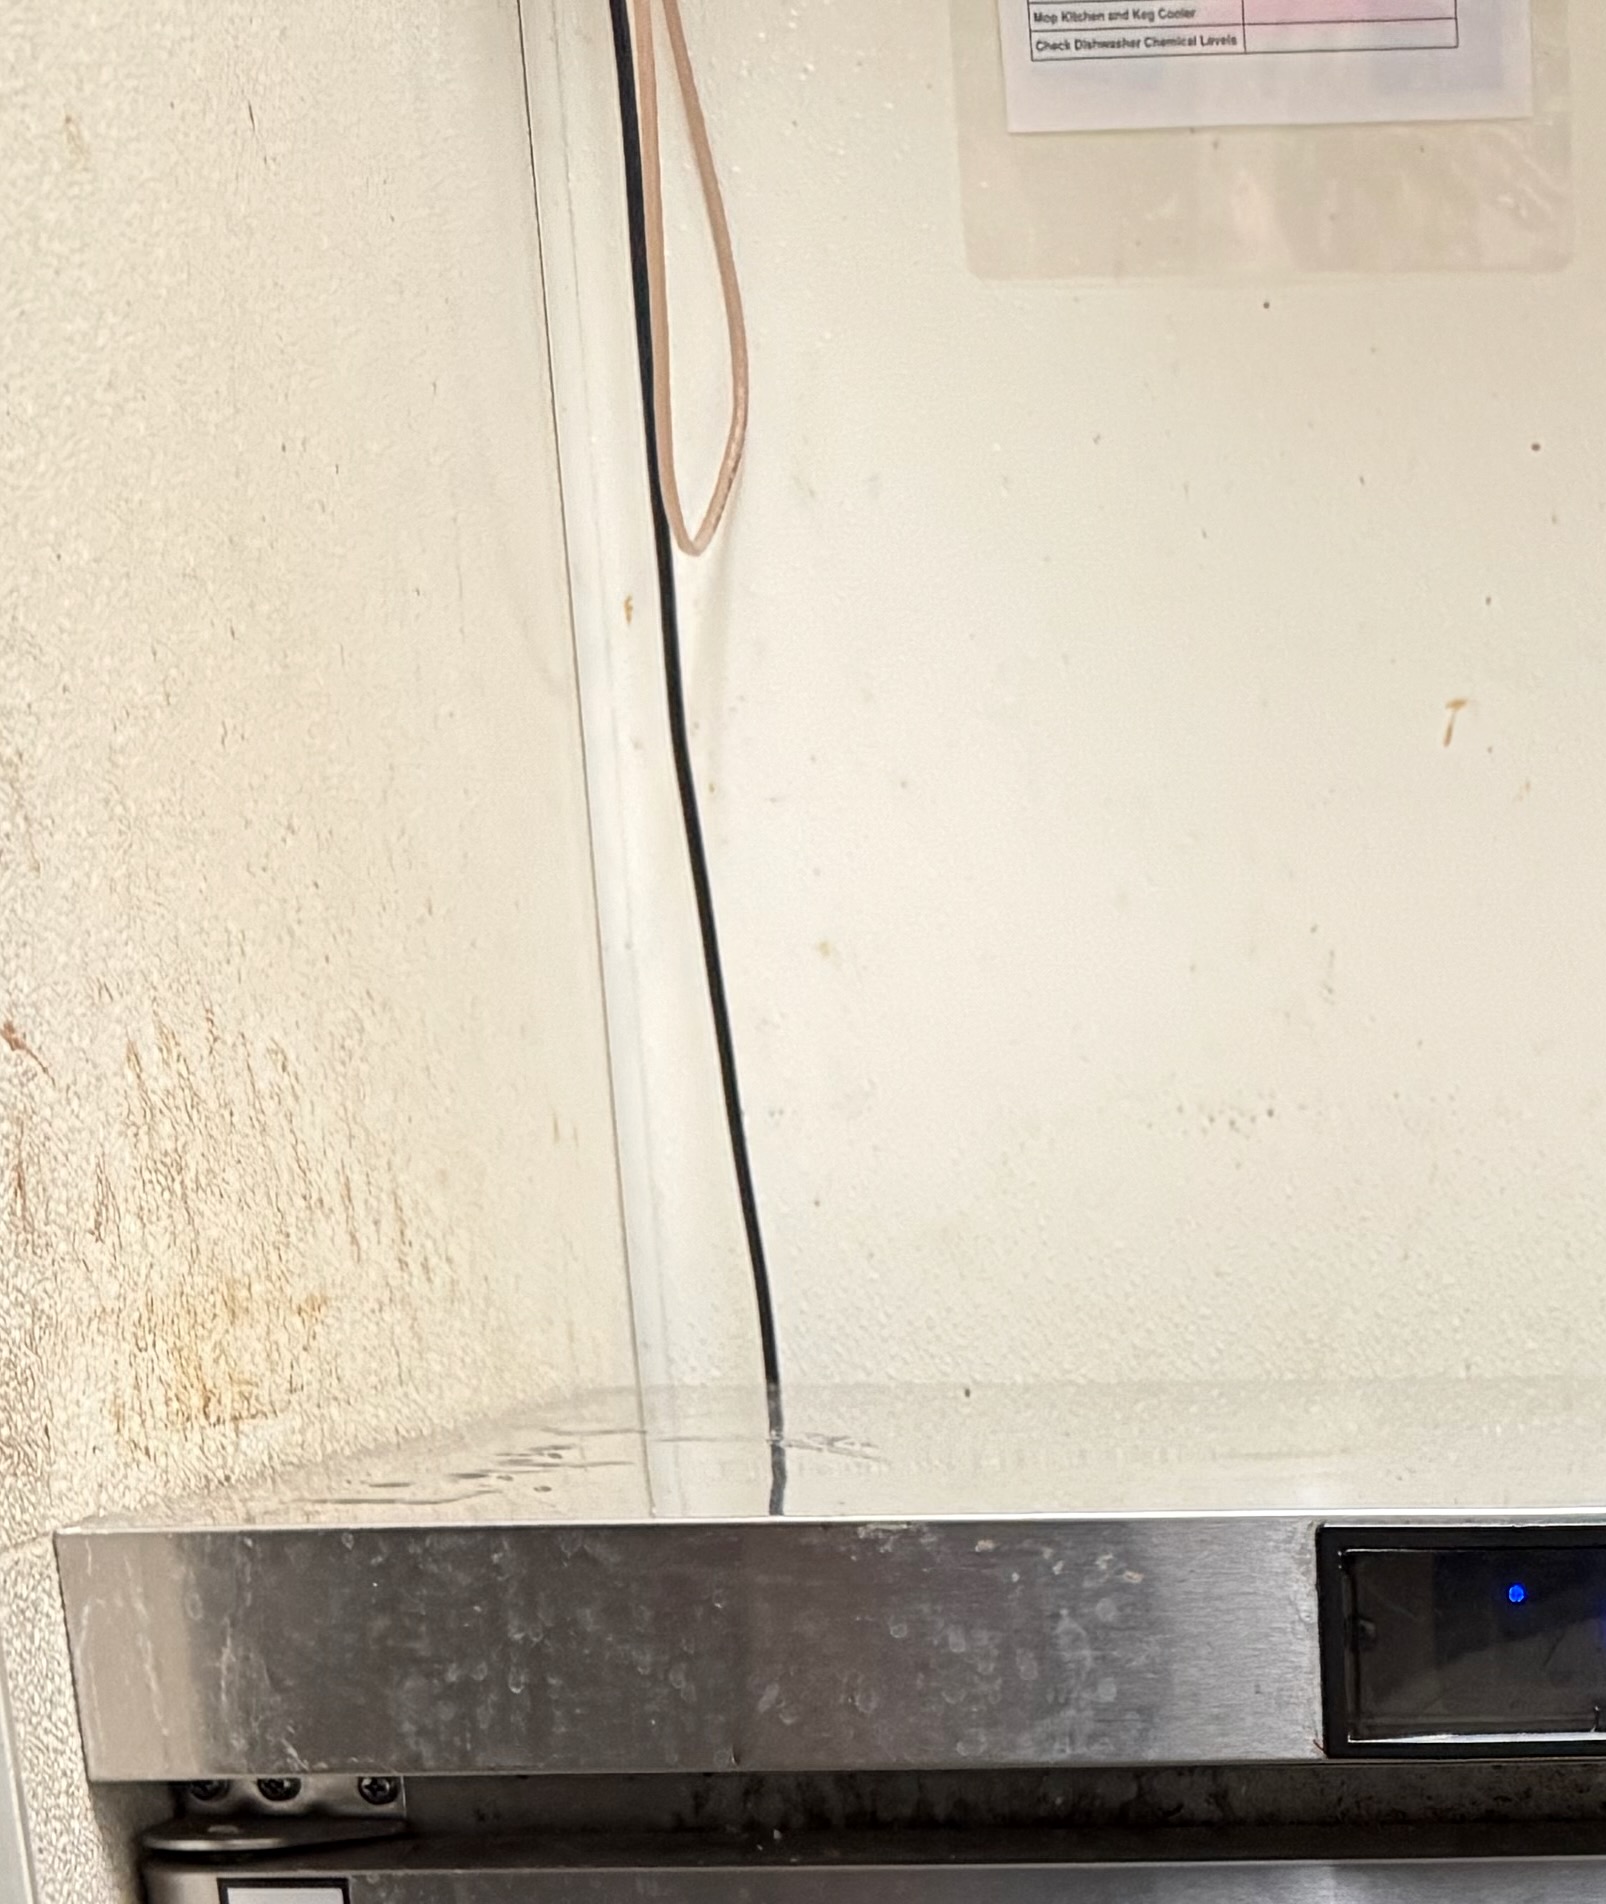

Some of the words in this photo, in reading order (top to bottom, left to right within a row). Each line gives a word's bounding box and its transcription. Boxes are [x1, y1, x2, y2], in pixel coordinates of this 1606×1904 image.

[1034, 11, 1058, 24] Mop
[1061, 9, 1105, 22] Kitchen
[1108, 11, 1129, 21] and
[1132, 8, 1156, 22] Keg
[1158, 7, 1196, 20] Cooler
[1036, 40, 1071, 51] Check
[1074, 36, 1141, 50] Dishwasher
[1144, 35, 1197, 48] Chemical
[1200, 34, 1238, 47] Levels
